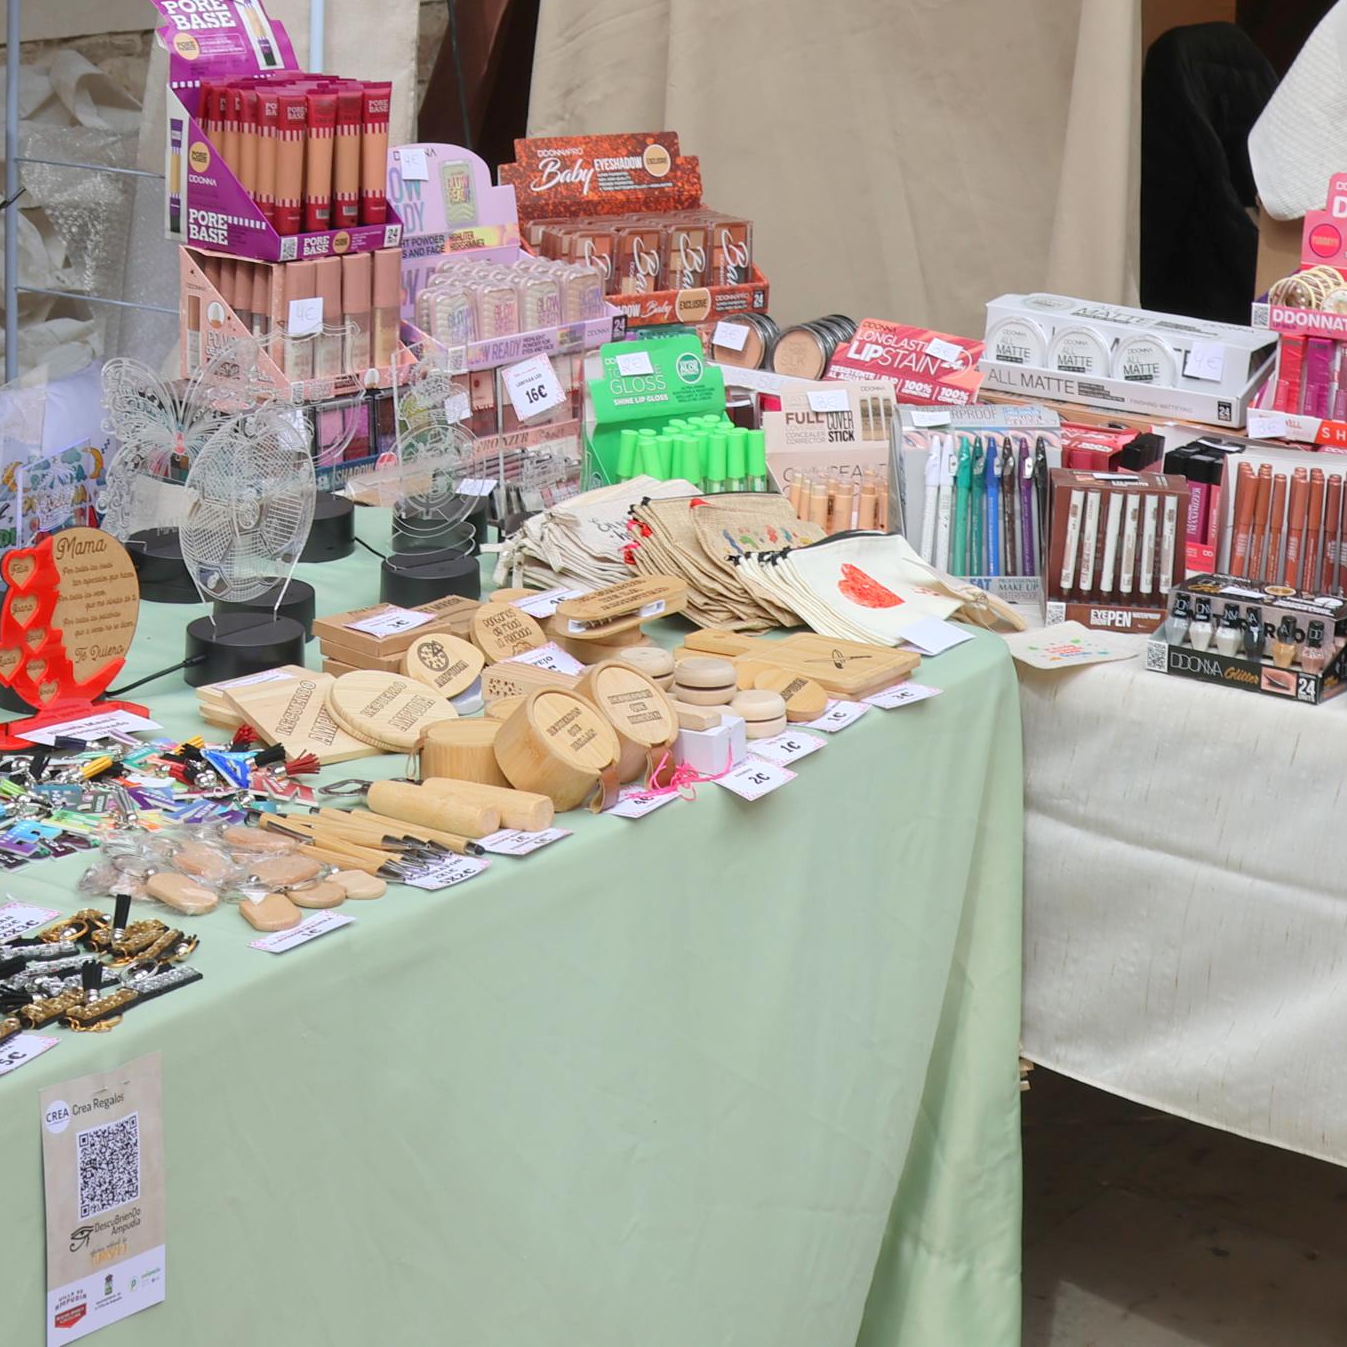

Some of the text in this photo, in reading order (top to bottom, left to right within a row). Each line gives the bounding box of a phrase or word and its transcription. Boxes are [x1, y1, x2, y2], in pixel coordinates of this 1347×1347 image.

[171, 12, 237, 30] BASE
[530, 157, 595, 196] Baby
[594, 156, 643, 172] EYESHADOW
[189, 208, 228, 229] PORE
[189, 224, 229, 246] BASE
[304, 236, 330, 247] PORE
[387, 229, 399, 239] 24
[412, 235, 445, 246] POWDER
[303, 245, 329, 256] BASE
[409, 245, 445, 258] AND FACE
[641, 301, 672, 318] Baby
[753, 294, 764, 304] 24
[615, 318, 625, 332] 24
[856, 329, 931, 348] LONGLASTI
[847, 340, 940, 375] LIPSTAIN
[996, 345, 1031, 359] MATTE
[1058, 354, 1093, 368] MATTE
[1123, 363, 1160, 375] MATTE
[610, 375, 667, 396] GLOSS
[904, 380, 933, 393] 100%
[940, 385, 969, 399] 100%
[988, 367, 1018, 387] ALL
[1020, 372, 1075, 395] MATTE
[1219, 405, 1231, 416] 24
[525, 385, 549, 404] 16€
[613, 397, 634, 406] SHINE
[635, 396, 645, 404] LIP
[646, 394, 668, 403] GLOSS
[785, 410, 854, 430] FULL COVER
[828, 430, 855, 442] STICK
[999, 583, 1040, 592] MAKE UP
[1108, 611, 1131, 628] PEN
[1170, 651, 1316, 695] DDONNA Glitter 24
[275, 680, 317, 736] RECUERDO
[360, 681, 408, 718] RECUERDO
[388, 693, 437, 732] AMPUDIA
[827, 711, 849, 722] 1€
[780, 740, 801, 754] 1€
[749, 772, 771, 785] 2€
[46, 1091, 125, 1124] CREA Crea Regalos
[110, 1217, 141, 1236] Ampudia
